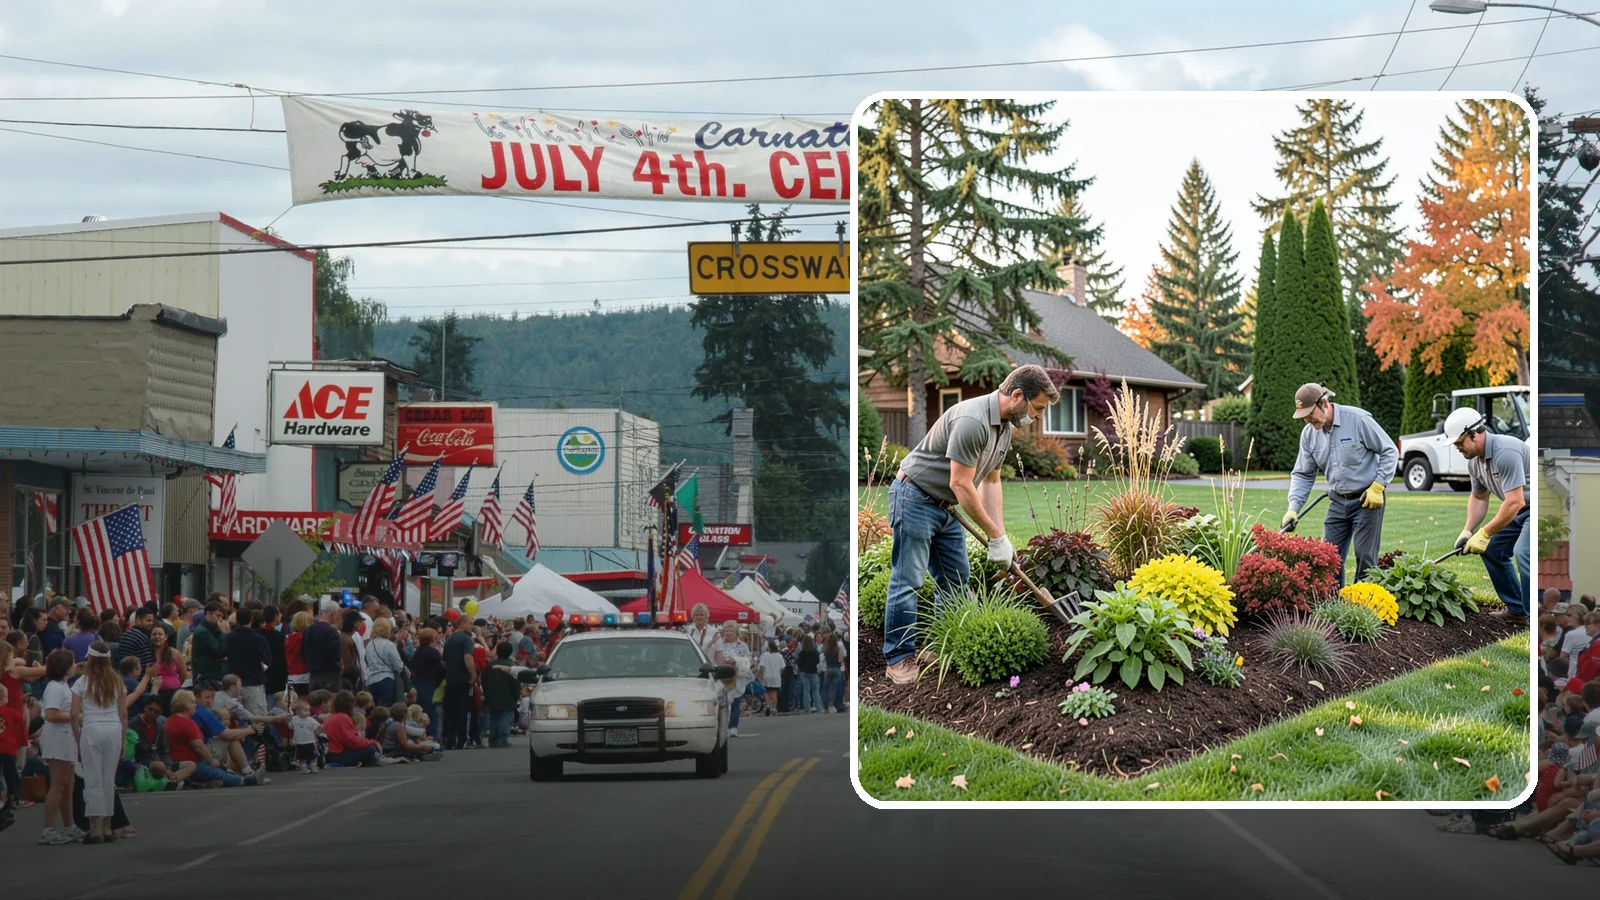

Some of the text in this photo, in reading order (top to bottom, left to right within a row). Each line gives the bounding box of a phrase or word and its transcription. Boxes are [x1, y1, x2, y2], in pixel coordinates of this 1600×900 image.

[694, 121, 850, 150] Carnat
[481, 140, 605, 193] JULY
[632, 150, 747, 198] 4th.
[697, 254, 850, 280] CROSSWA
[282, 380, 374, 420] ACE
[406, 409, 452, 422] CEDAR
[283, 421, 371, 437] Hardware
[353, 467, 387, 481] Simpl
[83, 485, 155, 496] St. Vincent de Paul
[212, 516, 331, 537] HARDARE
[688, 526, 741, 535] CRNATION
[699, 535, 730, 544] GLASS
